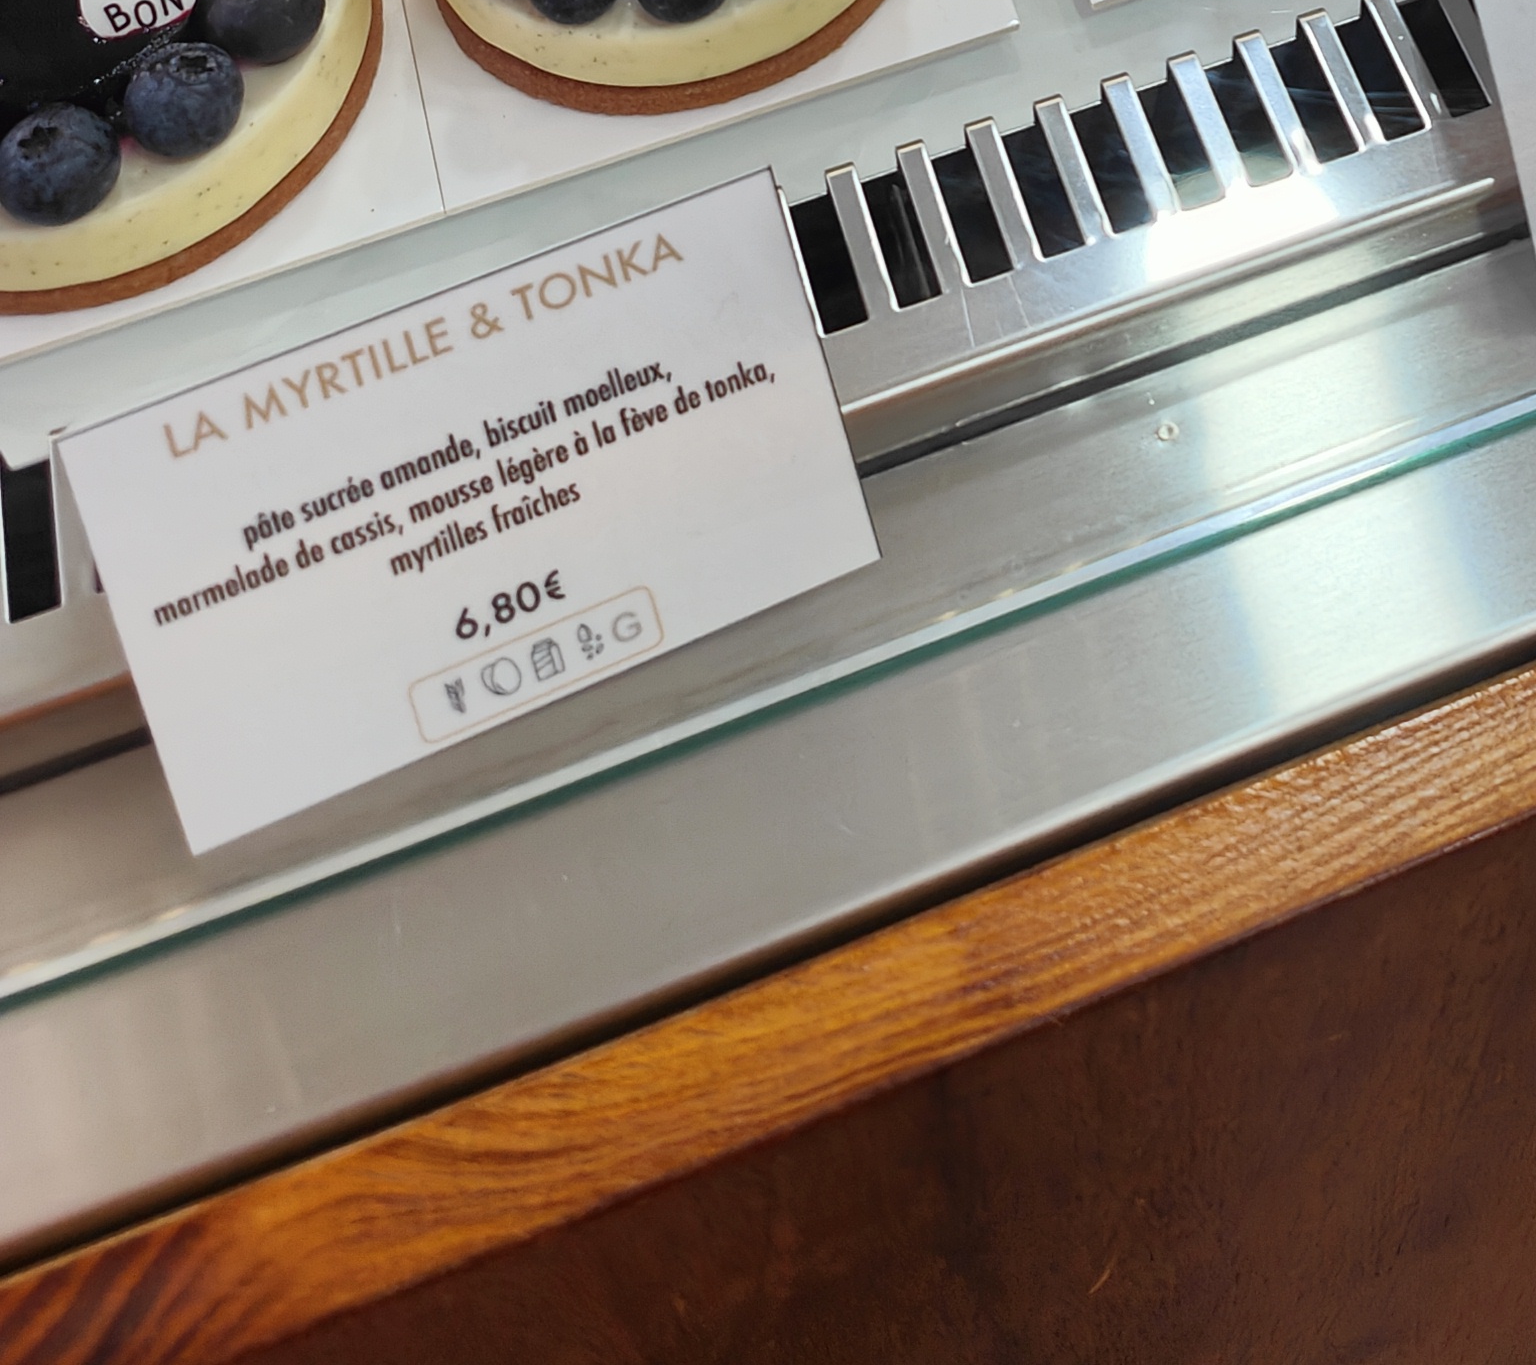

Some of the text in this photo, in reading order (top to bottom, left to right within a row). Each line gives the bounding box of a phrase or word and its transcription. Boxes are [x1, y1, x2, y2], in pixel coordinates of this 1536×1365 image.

[163, 233, 685, 459] LA MYRTILLE & TONKA
[153, 361, 775, 627] marmelade de cassis, mousse légère à la fève de tonka,
[241, 362, 672, 552] pâte sucrée amande, biscuit moelleux,
[389, 483, 581, 576] myrtilles fraîches
[454, 568, 567, 641] 6,80€
